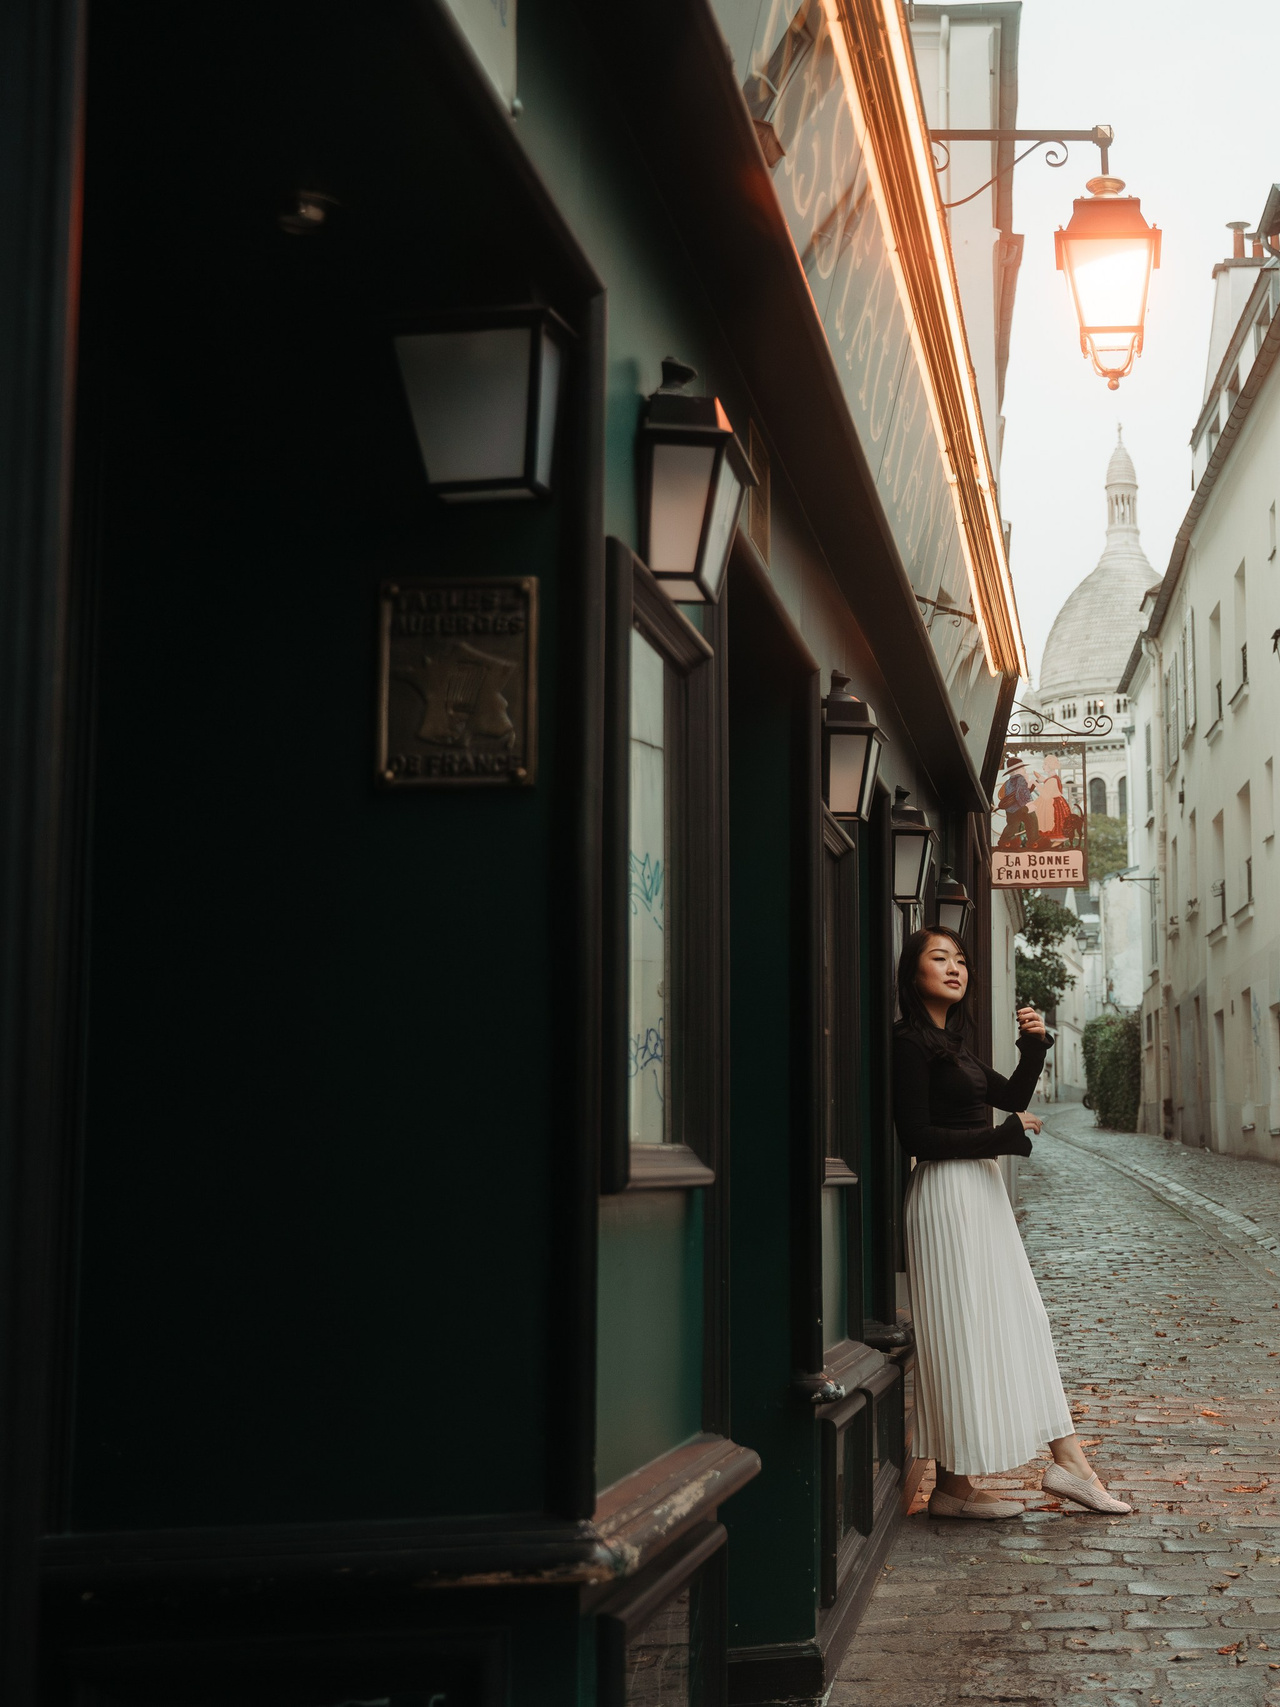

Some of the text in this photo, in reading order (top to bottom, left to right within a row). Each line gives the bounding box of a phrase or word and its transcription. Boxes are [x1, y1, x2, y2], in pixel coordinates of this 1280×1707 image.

[1004, 854, 1070, 867] LA BONNE
[996, 867, 1079, 880] FRANQUETTE
